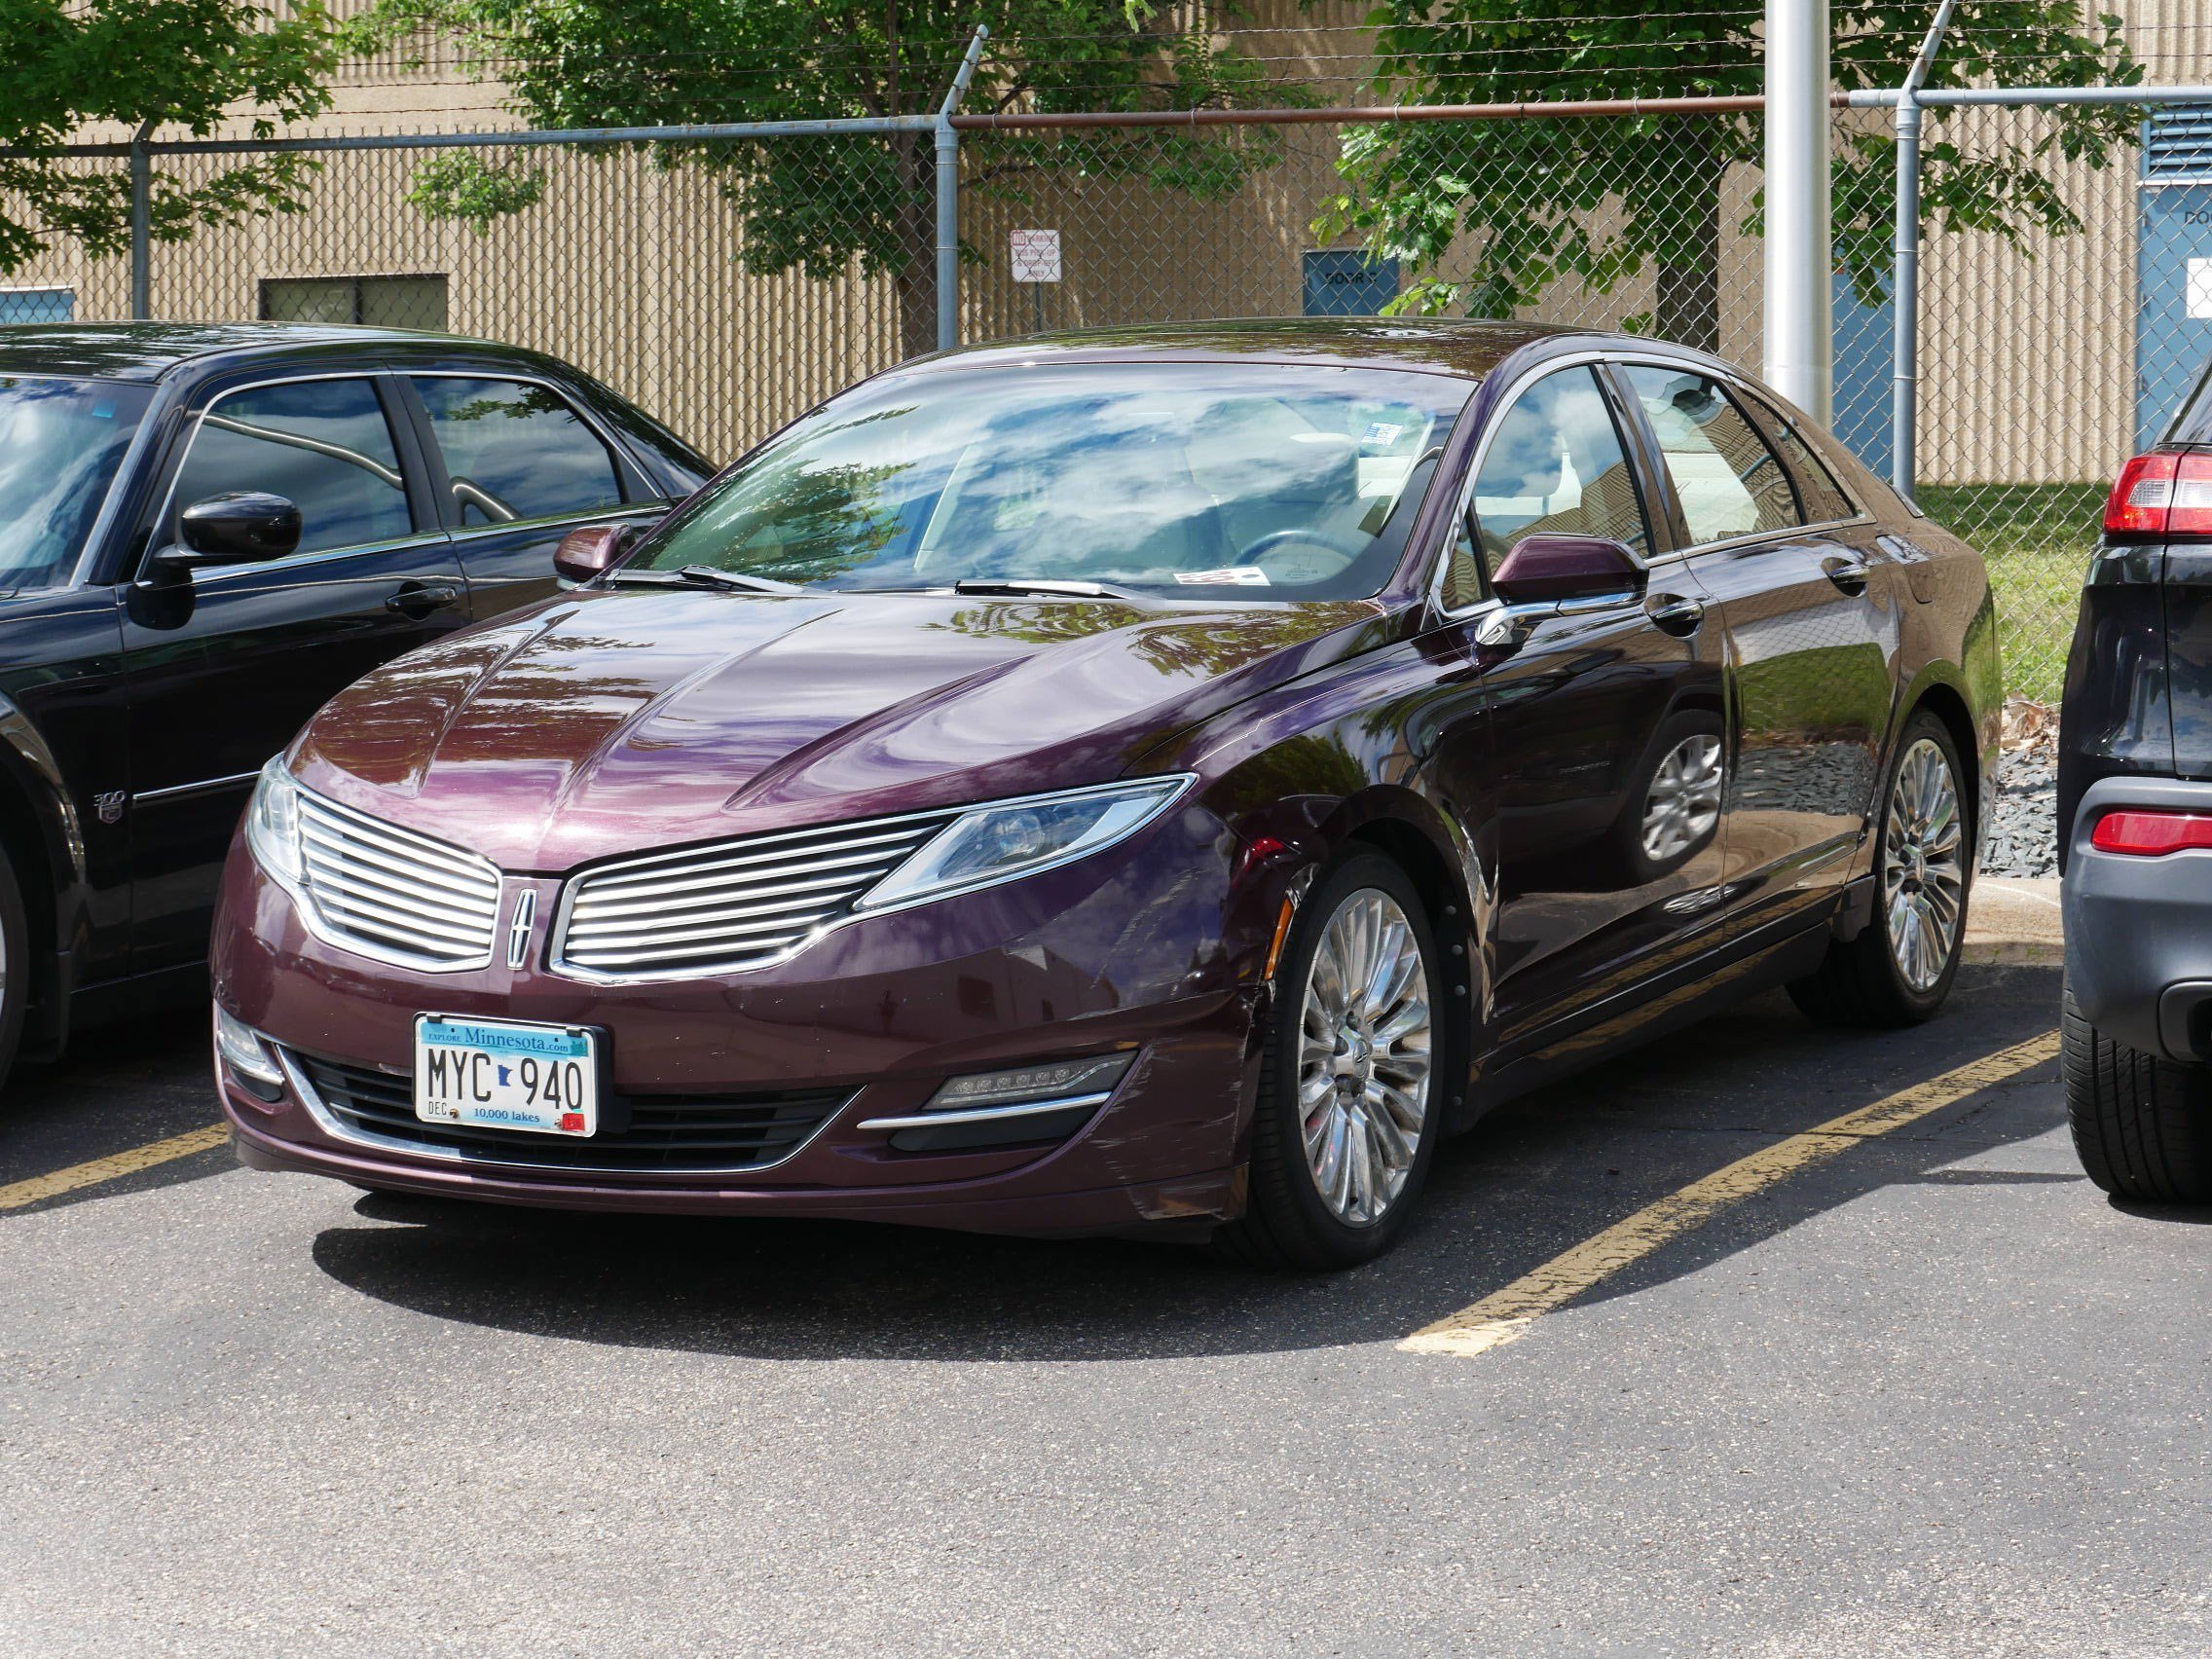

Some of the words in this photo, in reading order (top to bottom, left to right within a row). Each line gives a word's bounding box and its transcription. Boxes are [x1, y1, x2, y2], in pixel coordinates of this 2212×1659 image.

[1013, 232, 1025, 244] NO
[1325, 273, 1364, 285] DOOR
[93, 790, 126, 807] 300
[428, 1033, 461, 1043] EXPLORE
[427, 1048, 492, 1102] MYC
[520, 1057, 583, 1110] 940
[428, 1101, 447, 1116] DEC
[474, 1107, 508, 1120] 10,000
[511, 1108, 540, 1123] lakes
